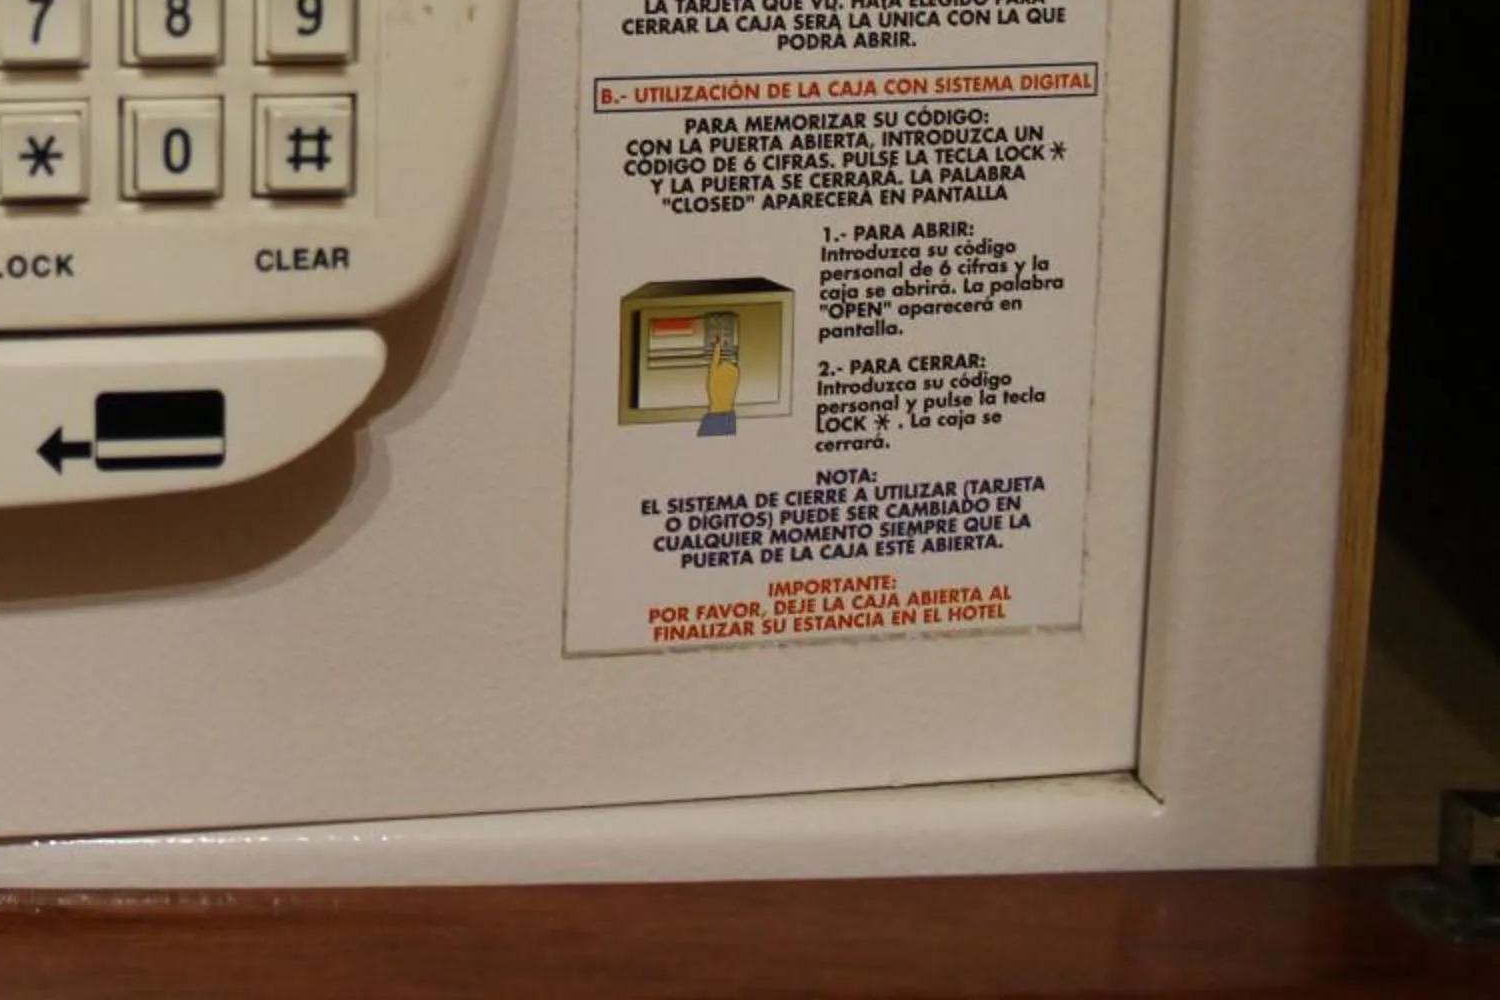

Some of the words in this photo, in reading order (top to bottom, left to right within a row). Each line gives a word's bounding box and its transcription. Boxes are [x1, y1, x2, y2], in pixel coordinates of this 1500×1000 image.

[620, 16, 698, 35] CERRAR
[734, 14, 786, 32] CAJA
[946, 9, 990, 27] CON
[1025, 7, 1065, 25] QUE
[852, 30, 916, 48] ABRIR.
[827, 79, 877, 97] CAJA
[883, 77, 928, 95] CON
[934, 75, 1013, 94] SISTEMA
[1019, 72, 1092, 91] DIGITAL
[684, 116, 738, 135] PARA
[744, 113, 866, 133] MEMORIZAR
[164, 128, 191, 173] 0
[625, 138, 672, 157] CON
[709, 135, 783, 154] PUERTA
[789, 132, 875, 154] ABIERTA,
[881, 127, 1008, 148] INTRODUZCA
[761, 153, 835, 172] CIFRAS.
[841, 150, 898, 169] PULSE
[934, 147, 989, 166] TECLA
[995, 145, 1045, 164] LOCK
[701, 174, 775, 193] PUERTA
[939, 165, 1025, 185] PALABRA
[661, 195, 755, 215] "CLOSED"
[911, 185, 1008, 205] PANTALLA
[852, 223, 906, 242] PARA
[910, 221, 974, 240] ABRIR:
[255, 247, 350, 271] CLEAR
[820, 242, 920, 262] Introduzca
[819, 262, 903, 287] personal
[956, 257, 1008, 276] cifras
[819, 283, 858, 306] caja
[989, 273, 1064, 298] palabra
[819, 300, 892, 319] "OPEN"
[817, 319, 904, 345] pantalla.
[848, 357, 902, 376] PARA
[906, 353, 986, 373] CERRAR:
[816, 376, 916, 397] Introduzca
[815, 396, 899, 421] personal
[923, 392, 973, 415] pulse
[1002, 388, 1045, 406] tecla
[815, 415, 866, 434] LOCK
[936, 410, 976, 433] caja
[815, 467, 878, 487] NOTA:
[666, 493, 749, 515] SISTEMA
[783, 488, 848, 508] CIERRE
[873, 481, 957, 502] UTILIZAR
[962, 476, 1045, 500] (TARJETA
[779, 506, 840, 526] PUEDE
[884, 497, 990, 520] CAMBIADO
[652, 529, 763, 553] CUALQUIER
[768, 523, 873, 546] MOMENTO
[879, 518, 957, 539] SIEMPRE
[963, 515, 1002, 533] QUE
[680, 548, 754, 570] PUERTA
[818, 541, 868, 561] CAJA
[920, 533, 1003, 554] ABIERTA.
[767, 575, 897, 598] IMPORTANTE:
[695, 600, 766, 624] FAVOR,
[773, 597, 816, 616] DEJE
[851, 592, 900, 611] CAJA
[905, 586, 982, 607] ABIERTA
[653, 618, 754, 642] FINALIZAR
[792, 610, 884, 633] ESTANCIA
[947, 603, 1006, 623] HOTEL
